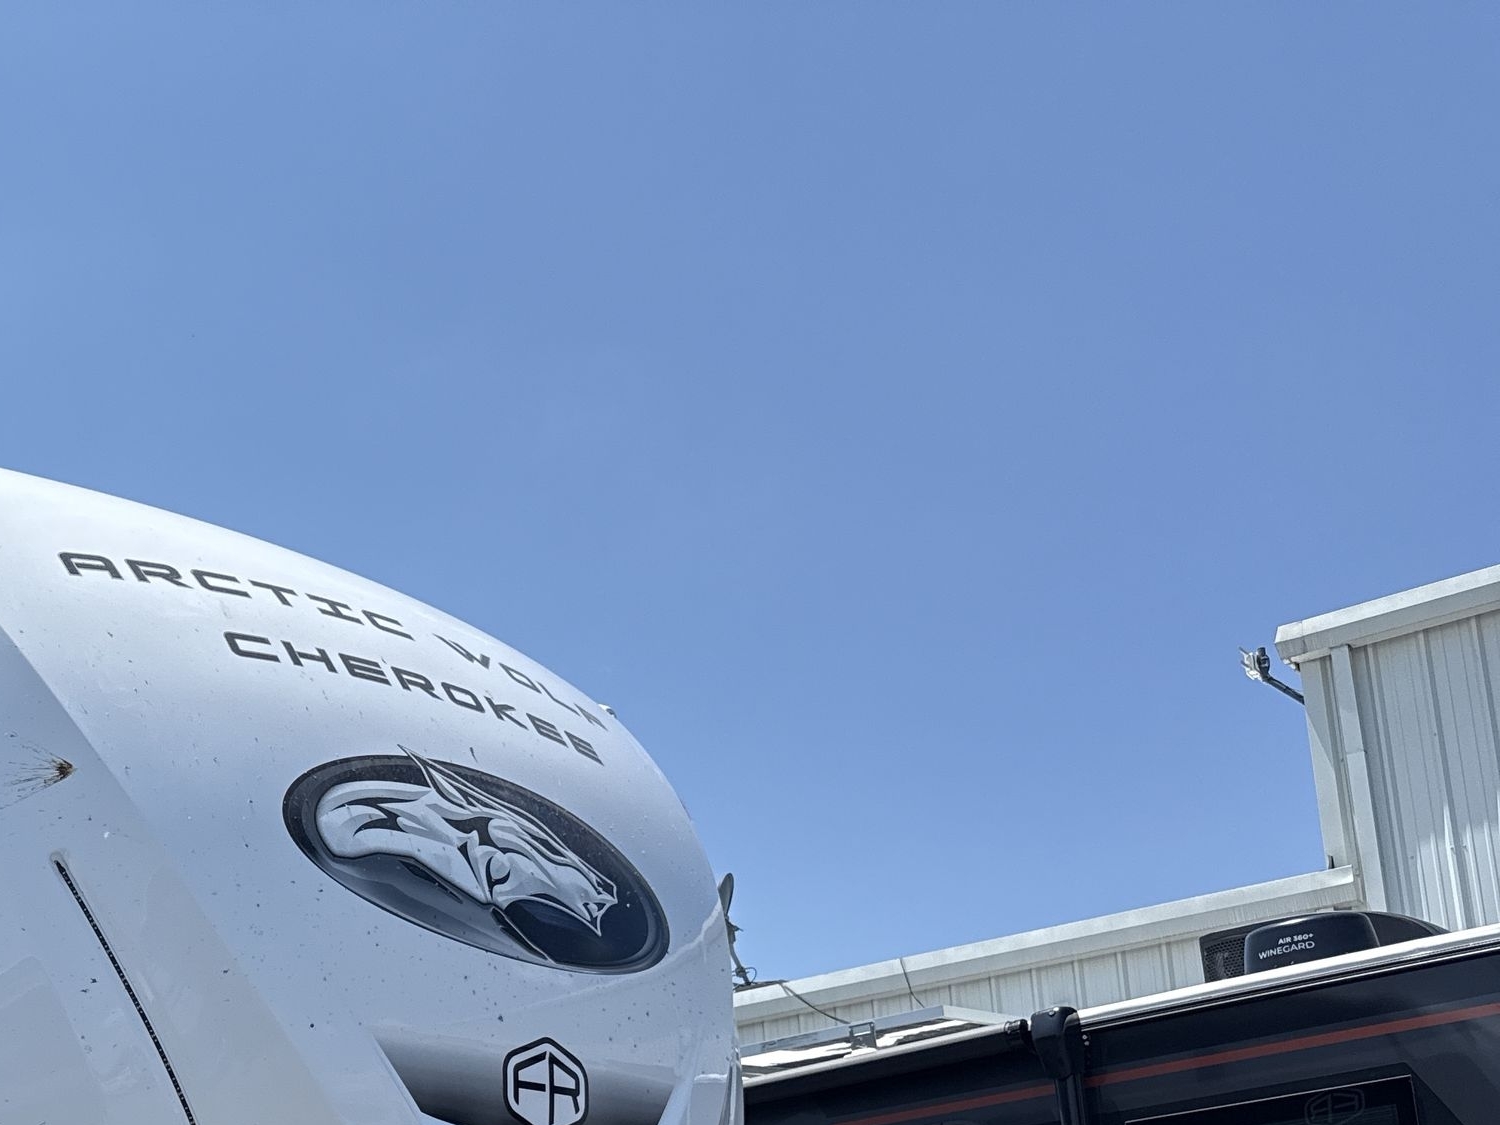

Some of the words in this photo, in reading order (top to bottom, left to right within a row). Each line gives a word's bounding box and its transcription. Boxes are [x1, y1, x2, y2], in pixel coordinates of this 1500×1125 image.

[57, 551, 416, 642] ARCTIC
[432, 632, 610, 732] WOLF
[222, 630, 605, 767] CHEROKEE
[1258, 940, 1316, 960] WINEGARD
[1278, 936, 1292, 945] AIR
